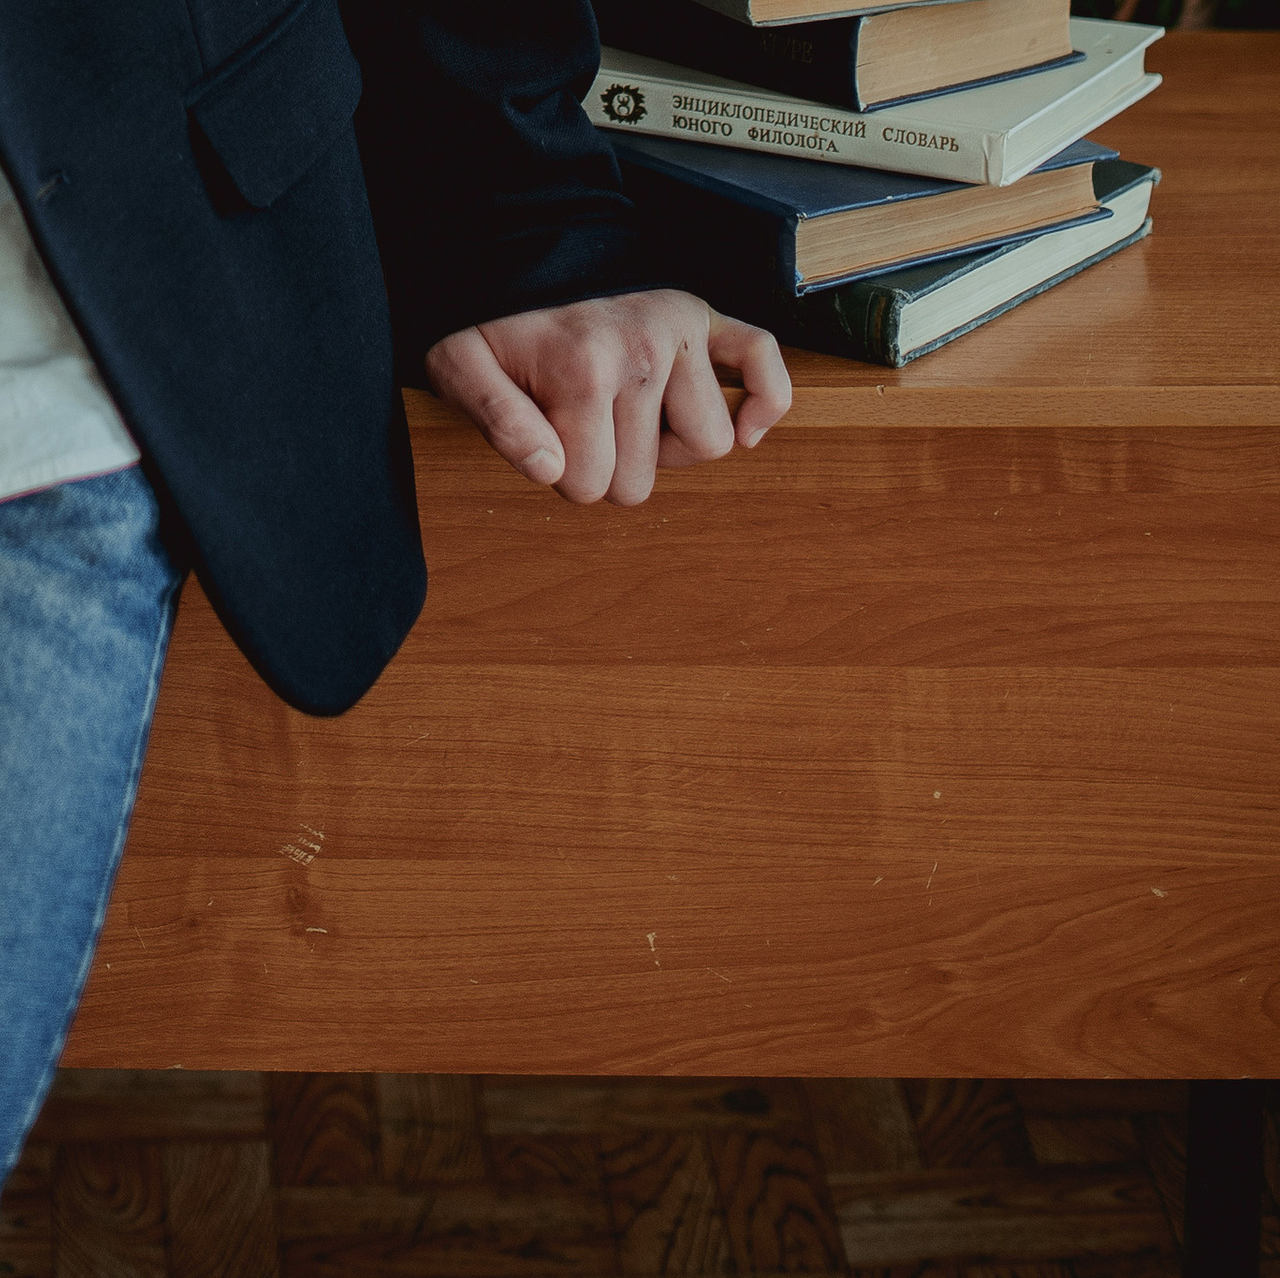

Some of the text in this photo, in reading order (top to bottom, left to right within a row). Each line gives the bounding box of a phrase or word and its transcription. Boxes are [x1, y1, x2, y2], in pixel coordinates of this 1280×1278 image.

[671, 94, 960, 153] ЭНЦИКЛОПЕДИЧЕСКИЙ СЛОВАРЬ
[671, 115, 839, 153] ЮНОГО ФИЛОЛОГА
